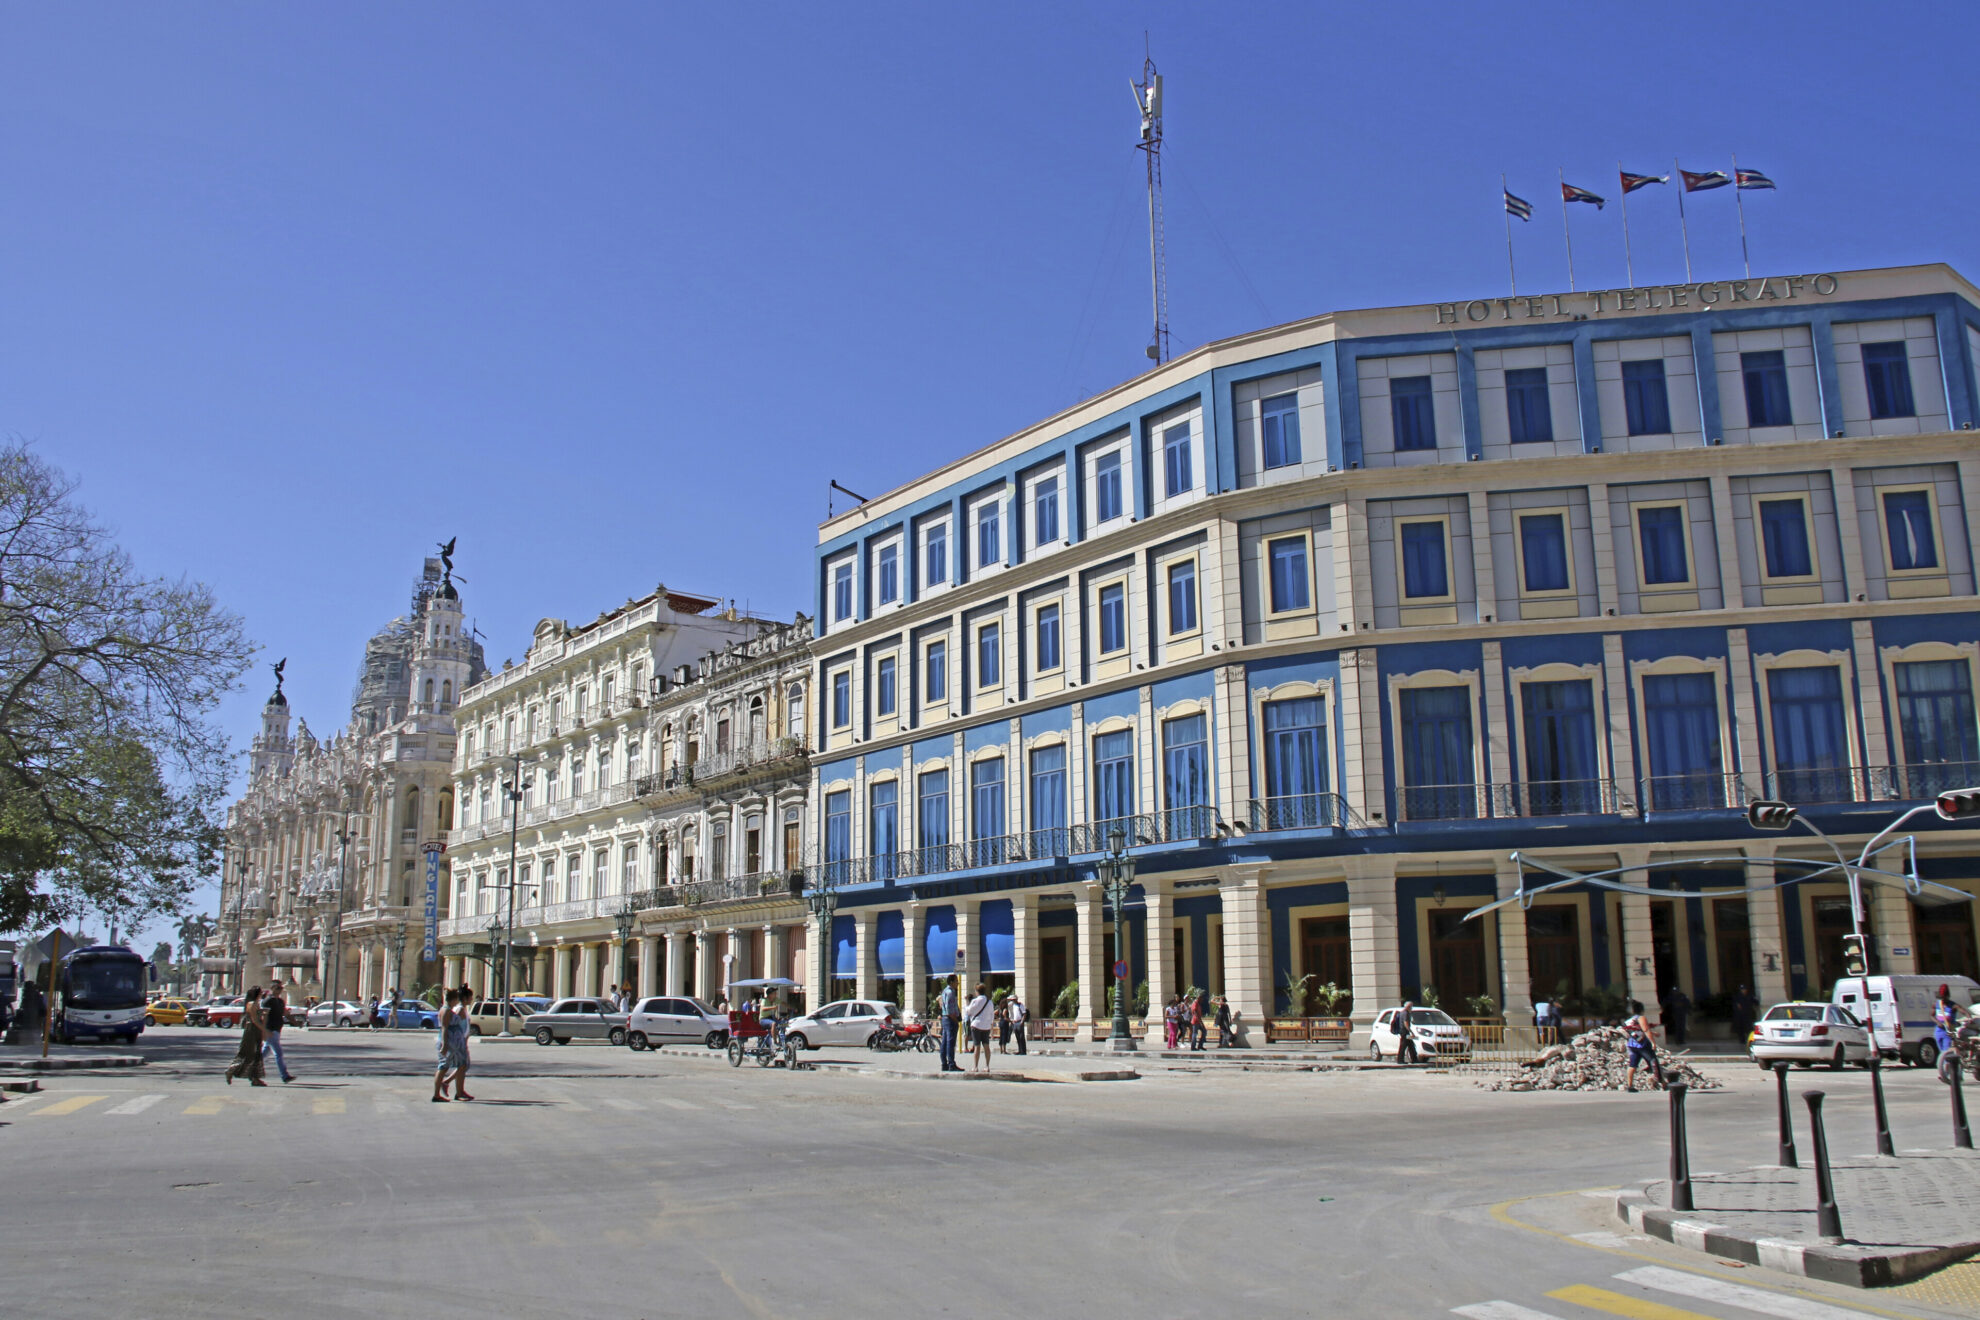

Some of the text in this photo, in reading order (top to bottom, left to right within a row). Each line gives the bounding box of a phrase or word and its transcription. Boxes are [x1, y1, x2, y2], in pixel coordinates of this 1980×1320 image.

[1435, 272, 1839, 325] HOTEL TELEGRAFO
[424, 851, 436, 959] INGLATERRA
